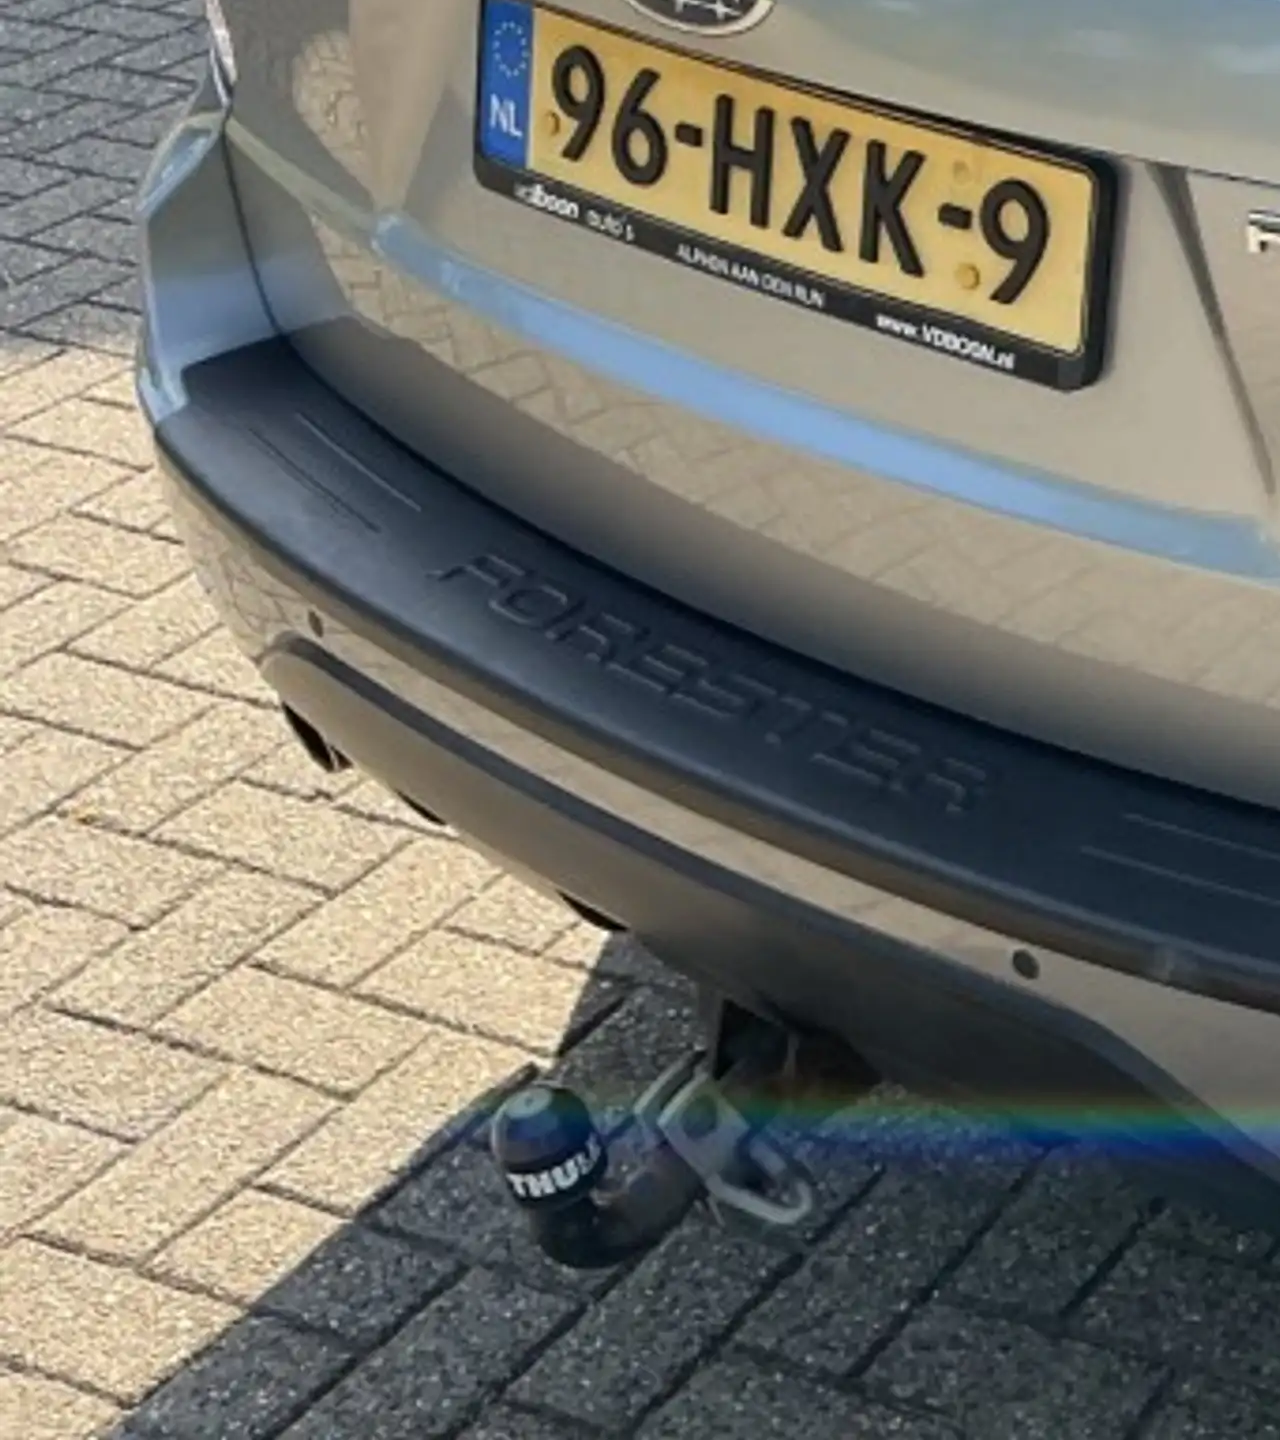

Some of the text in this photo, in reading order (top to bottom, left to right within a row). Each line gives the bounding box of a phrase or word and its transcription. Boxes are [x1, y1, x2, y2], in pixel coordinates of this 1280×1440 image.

[489, 95, 523, 141] NL
[551, 45, 1051, 305] 96-HXK-9
[427, 552, 988, 816] FORESTER
